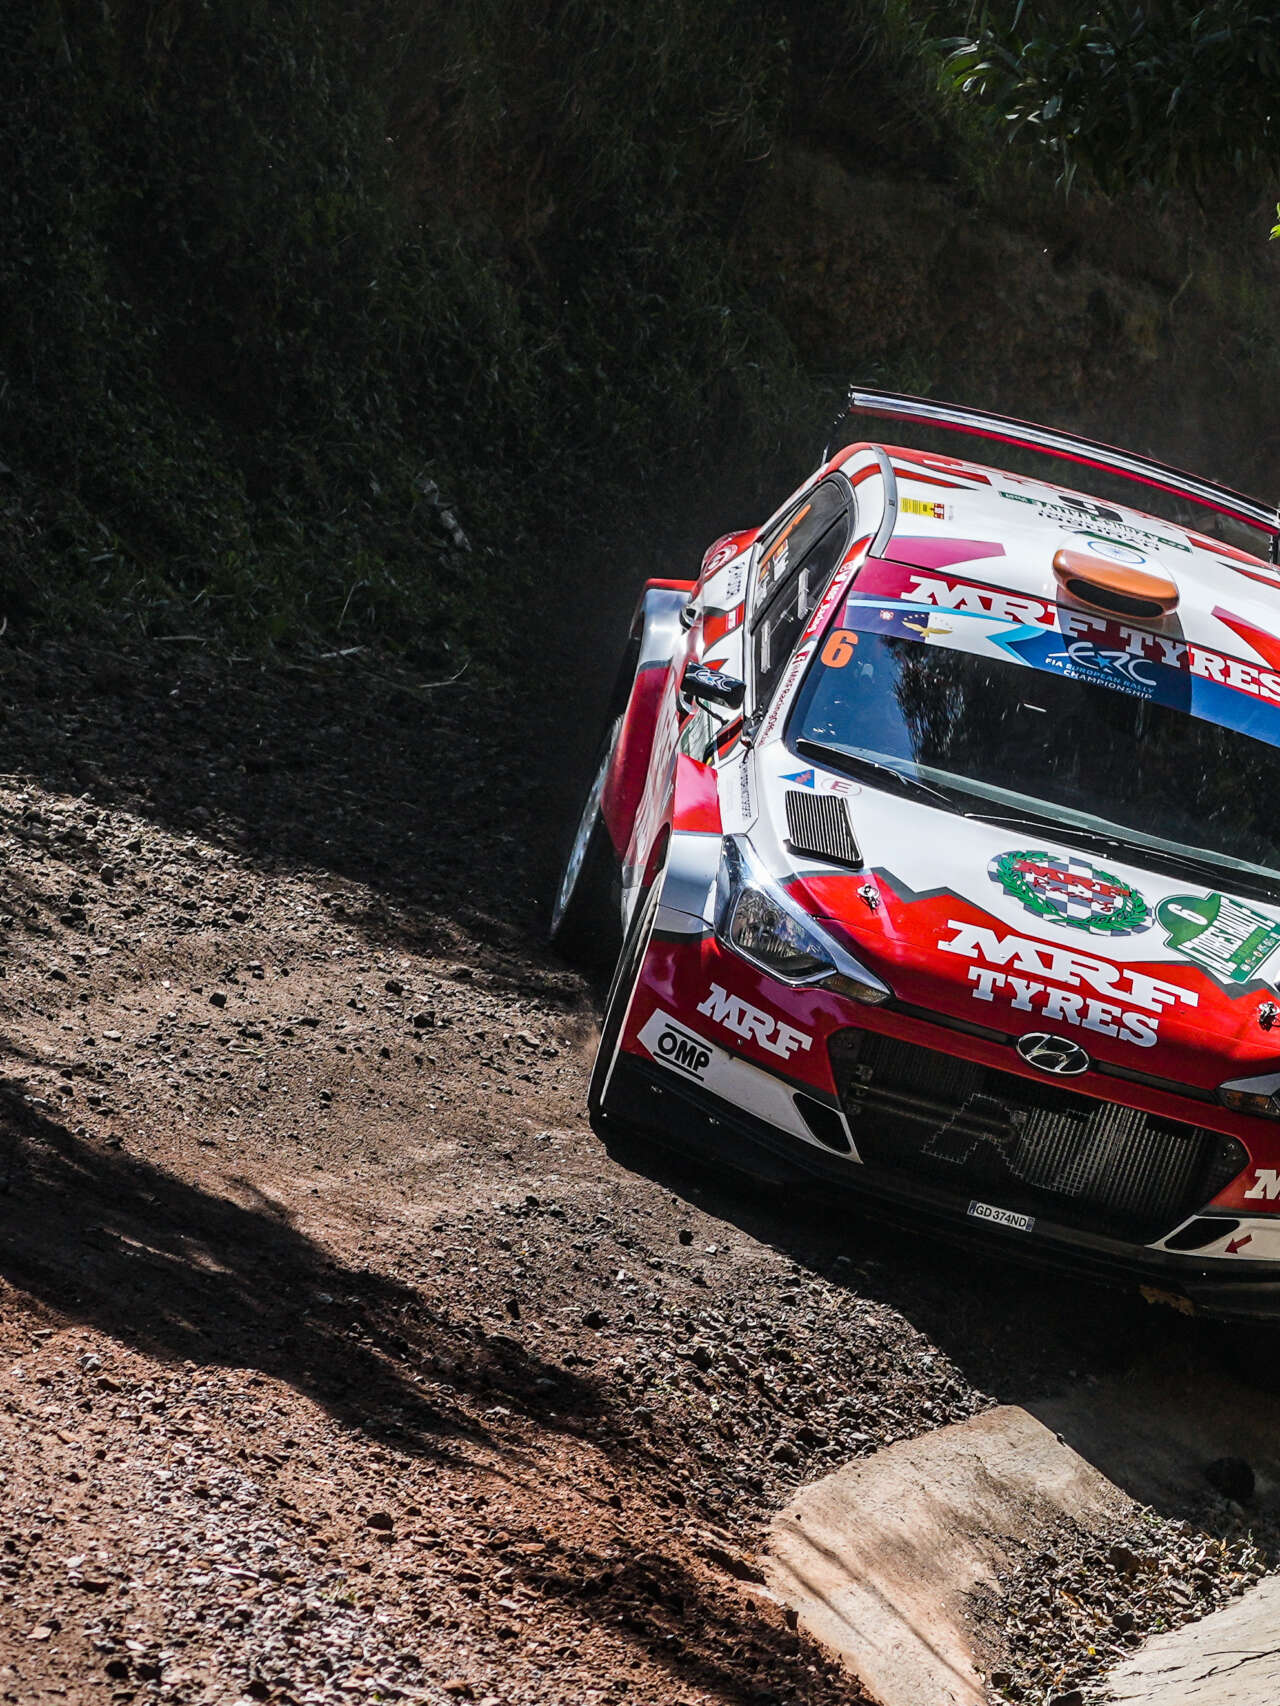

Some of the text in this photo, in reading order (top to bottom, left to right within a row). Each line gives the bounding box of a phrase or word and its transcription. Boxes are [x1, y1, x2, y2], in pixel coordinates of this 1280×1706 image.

[901, 575, 1106, 638] MRF
[820, 629, 859, 669] 6
[1045, 657, 1154, 694] FIA EUROPEAN RALLY
[1063, 669, 1152, 699] CHAMPIONSHIP
[1012, 859, 1131, 898] MRF
[1167, 903, 1209, 926] 6
[1176, 926, 1243, 975] AZORES
[1211, 895, 1276, 941] RALLYE
[937, 919, 1199, 1013] MRF
[696, 982, 813, 1060] MRF
[967, 965, 1158, 1047] TYRES
[657, 1031, 710, 1073] OMP
[975, 1205, 1027, 1227] GD 374ND
